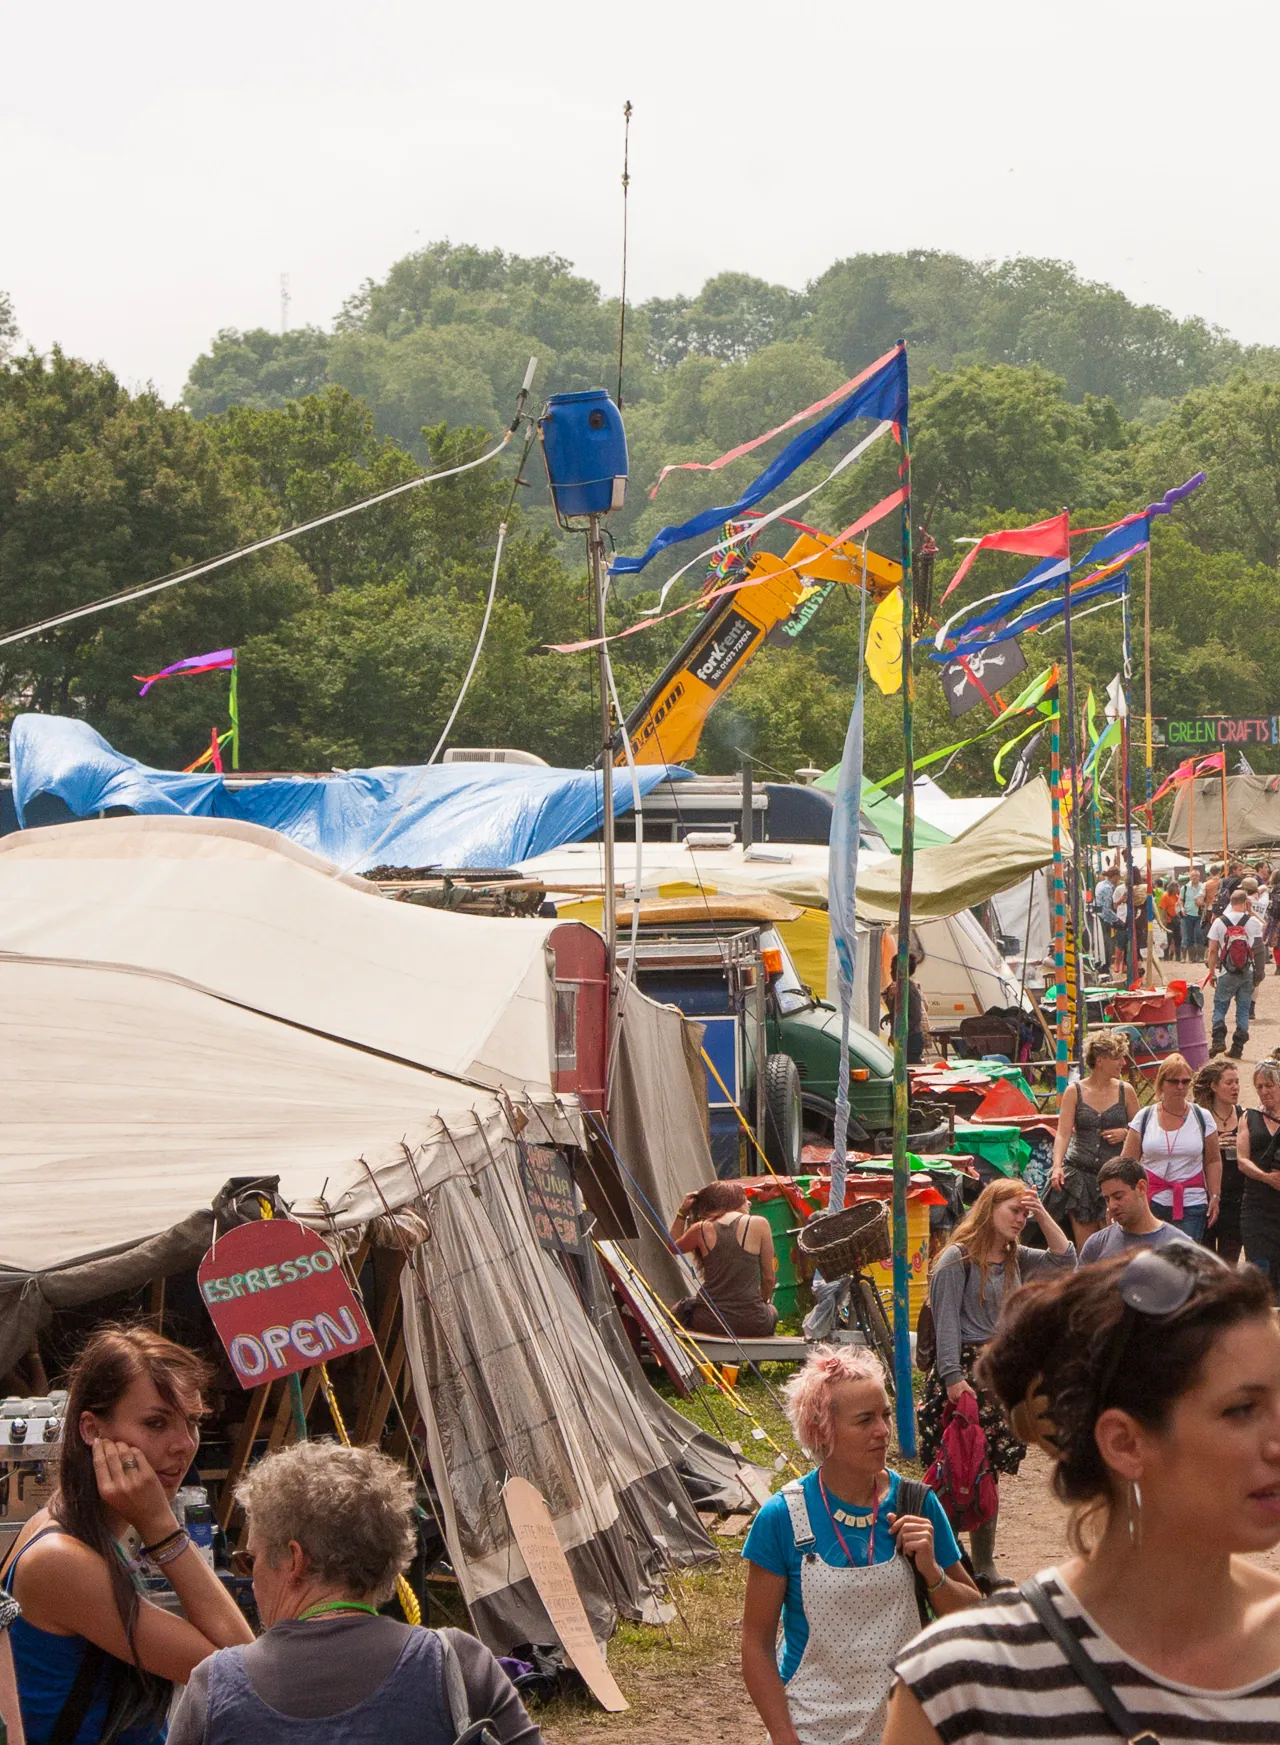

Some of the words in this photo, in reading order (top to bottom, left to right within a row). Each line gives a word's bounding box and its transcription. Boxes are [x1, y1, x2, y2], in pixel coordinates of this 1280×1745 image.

[696, 620, 747, 680] forkrent
[1168, 720, 1215, 744] GREEN
[1217, 719, 1270, 743] CRAFTS
[1110, 831, 1139, 845] CAE
[202, 1250, 336, 1304] ESPRESSO
[230, 1305, 361, 1377] OPEN
